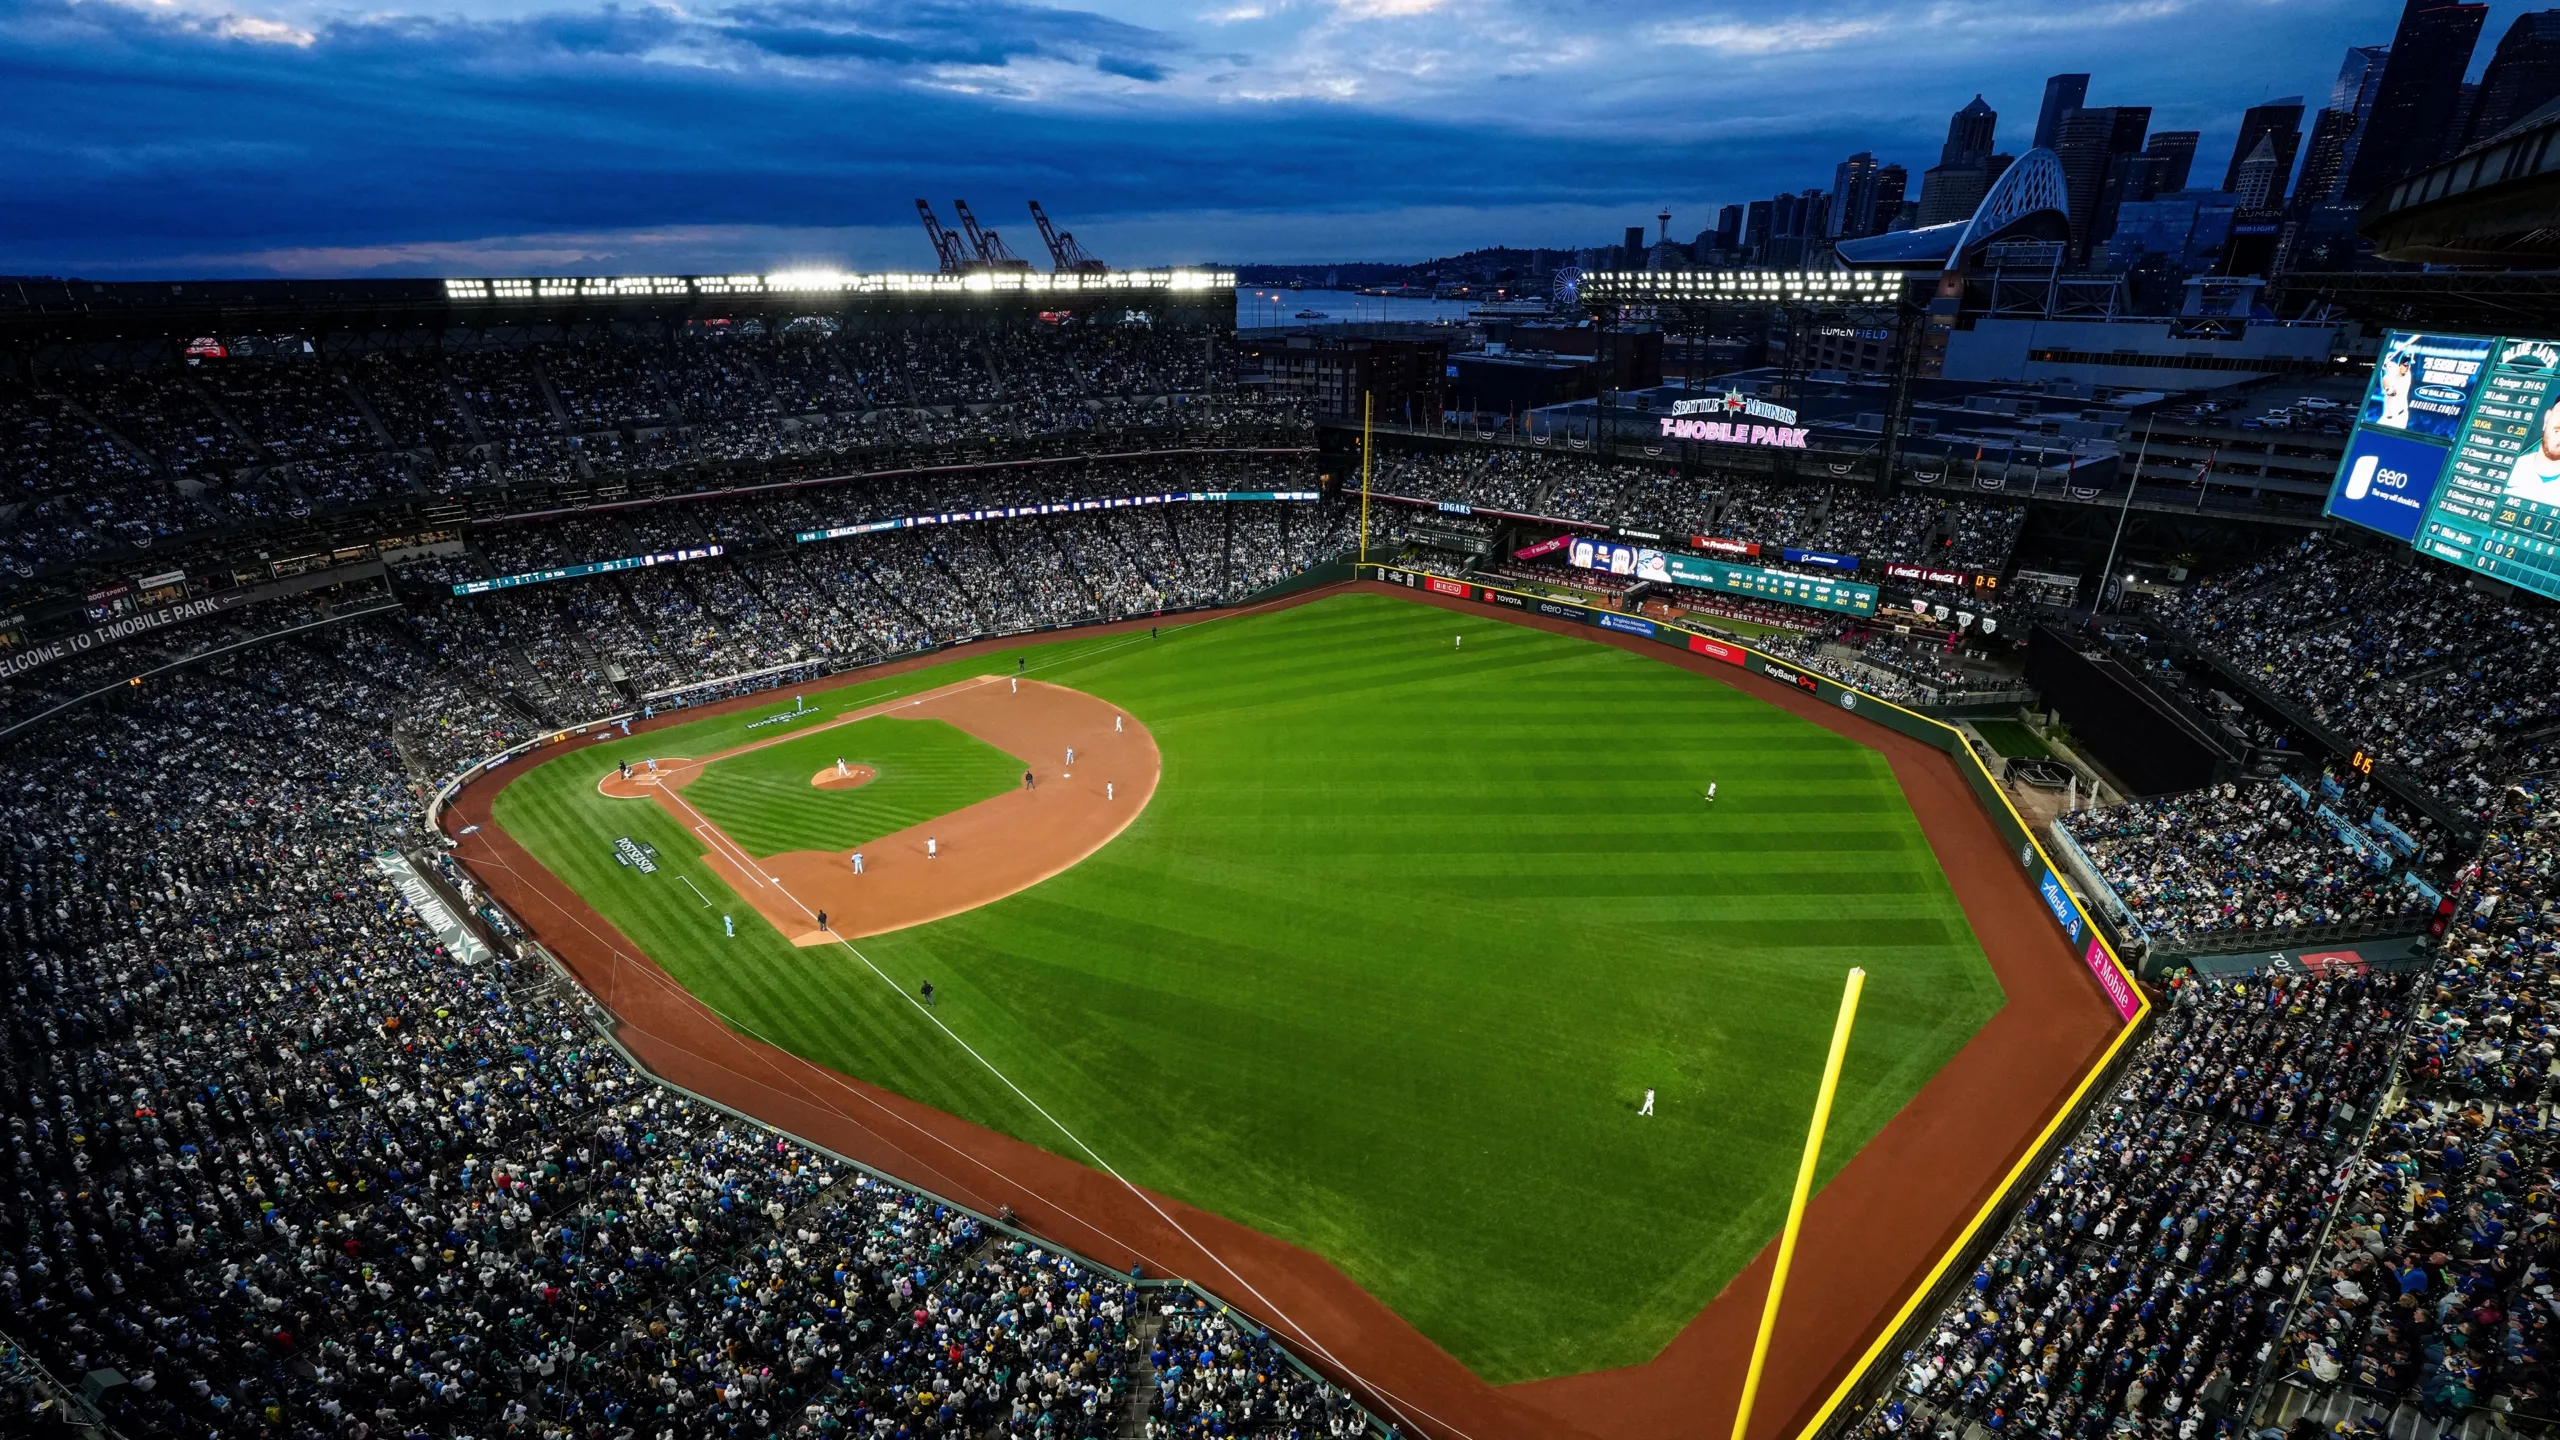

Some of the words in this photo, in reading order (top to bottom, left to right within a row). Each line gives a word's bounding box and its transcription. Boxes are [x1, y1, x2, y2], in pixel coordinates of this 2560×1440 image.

[1822, 328, 1854, 337] LUMEN
[1856, 329, 1888, 339] FIELD
[2502, 342, 2533, 364] BLUE
[2532, 342, 2559, 369] JAYS
[2498, 378, 2522, 390] Springer
[2523, 380, 2534, 389] DH
[2491, 392, 2509, 402] Lukes
[2518, 395, 2528, 404] LF
[2530, 397, 2540, 405] 1B
[1672, 398, 1720, 416] SEATTLE
[1745, 398, 1797, 425] MARINERS
[1660, 418, 1750, 443] T-MOBILE
[1750, 425, 1810, 448] PARK
[2479, 420, 2492, 429] Kirk
[2507, 426, 2514, 434] C
[2475, 435, 2493, 445] Varsho
[2499, 440, 2509, 448] CF
[2469, 449, 2492, 460] Clement
[2376, 468, 2408, 489] eero
[2380, 492, 2389, 500] way
[2397, 496, 2412, 506] should
[2475, 497, 2484, 506] SS
[2485, 499, 2495, 509] HR
[2506, 497, 2521, 507] AVG
[2530, 503, 2537, 511] R
[2550, 508, 2559, 517] H
[840, 527, 857, 535] ALCS
[2524, 516, 2531, 526] 6
[2544, 522, 2552, 531] 7
[1627, 530, 1661, 540] STARBUCKS
[2440, 527, 2455, 539] Blue
[2456, 533, 2472, 545] Jays
[2484, 540, 2492, 551] 0
[2495, 544, 2503, 554] 0
[2506, 548, 2514, 558] 2
[2501, 532, 2508, 541] 2
[2524, 540, 2531, 548] 4
[2536, 543, 2542, 552] 5
[2547, 547, 2554, 555] 6
[2435, 542, 2462, 559] Mariners
[2478, 557, 2485, 567] 0
[2490, 560, 2496, 570] 1
[1672, 570, 1700, 580] Alejandro
[1976, 575, 1996, 588] 0:15
[1436, 581, 1459, 593] BECU
[1512, 570, 1537, 580] BIGGEST
[1584, 584, 1624, 596] NORTHWEST
[87, 592, 105, 601] ROOT
[106, 586, 128, 596] SPORTS
[1496, 595, 1522, 605] TOYOTA
[1541, 604, 1561, 614] eero
[1692, 605, 1723, 616] BIGGEST
[1733, 612, 1751, 621] BEST
[1764, 617, 1780, 627] THE
[1613, 622, 1636, 631] Franciscan
[0, 642, 64, 678] ELCOME
[66, 634, 91, 652] TO
[94, 609, 172, 643] T-MOBILE
[173, 597, 219, 620] PARK
[1765, 664, 1797, 683] KeyBank
[2353, 752, 2373, 774] 0:15
[2328, 815, 2351, 833] J-ROD
[2354, 831, 2380, 856] SQUAD
[615, 838, 657, 873] POSTSEASON
[2043, 882, 2067, 919] Alaska
[2094, 948, 2104, 964] T
[2100, 964, 2129, 1008] Mobile
